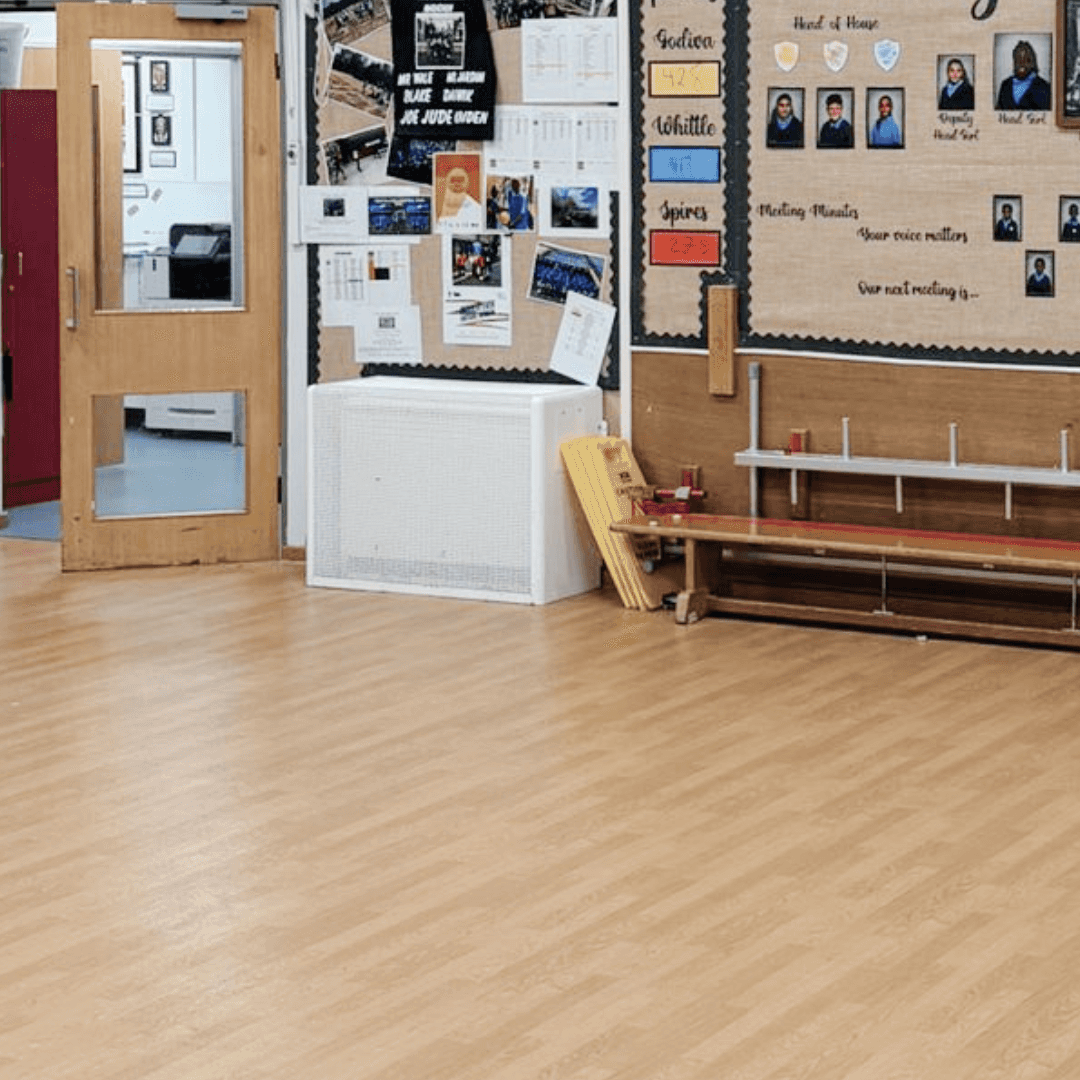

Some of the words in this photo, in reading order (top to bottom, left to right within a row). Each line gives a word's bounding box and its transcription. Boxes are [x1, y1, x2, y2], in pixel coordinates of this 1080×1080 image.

[794, 14, 825, 30] Head
[830, 14, 841, 31] of
[846, 14, 879, 30] House
[654, 26, 715, 50] Godiva
[421, 109, 453, 125] JUDE
[652, 114, 717, 136] Whittle
[937, 112, 974, 127] Deputy
[998, 112, 1023, 126] Head
[934, 129, 957, 142] Head
[660, 199, 710, 228] Spires
[757, 202, 806, 220] Meeting
[809, 203, 860, 220] Minutes
[857, 227, 891, 244] Your
[893, 229, 922, 242] voice
[925, 226, 968, 244] matters
[858, 280, 881, 295] Our
[885, 280, 910, 295] next
[912, 280, 957, 301] meeting
